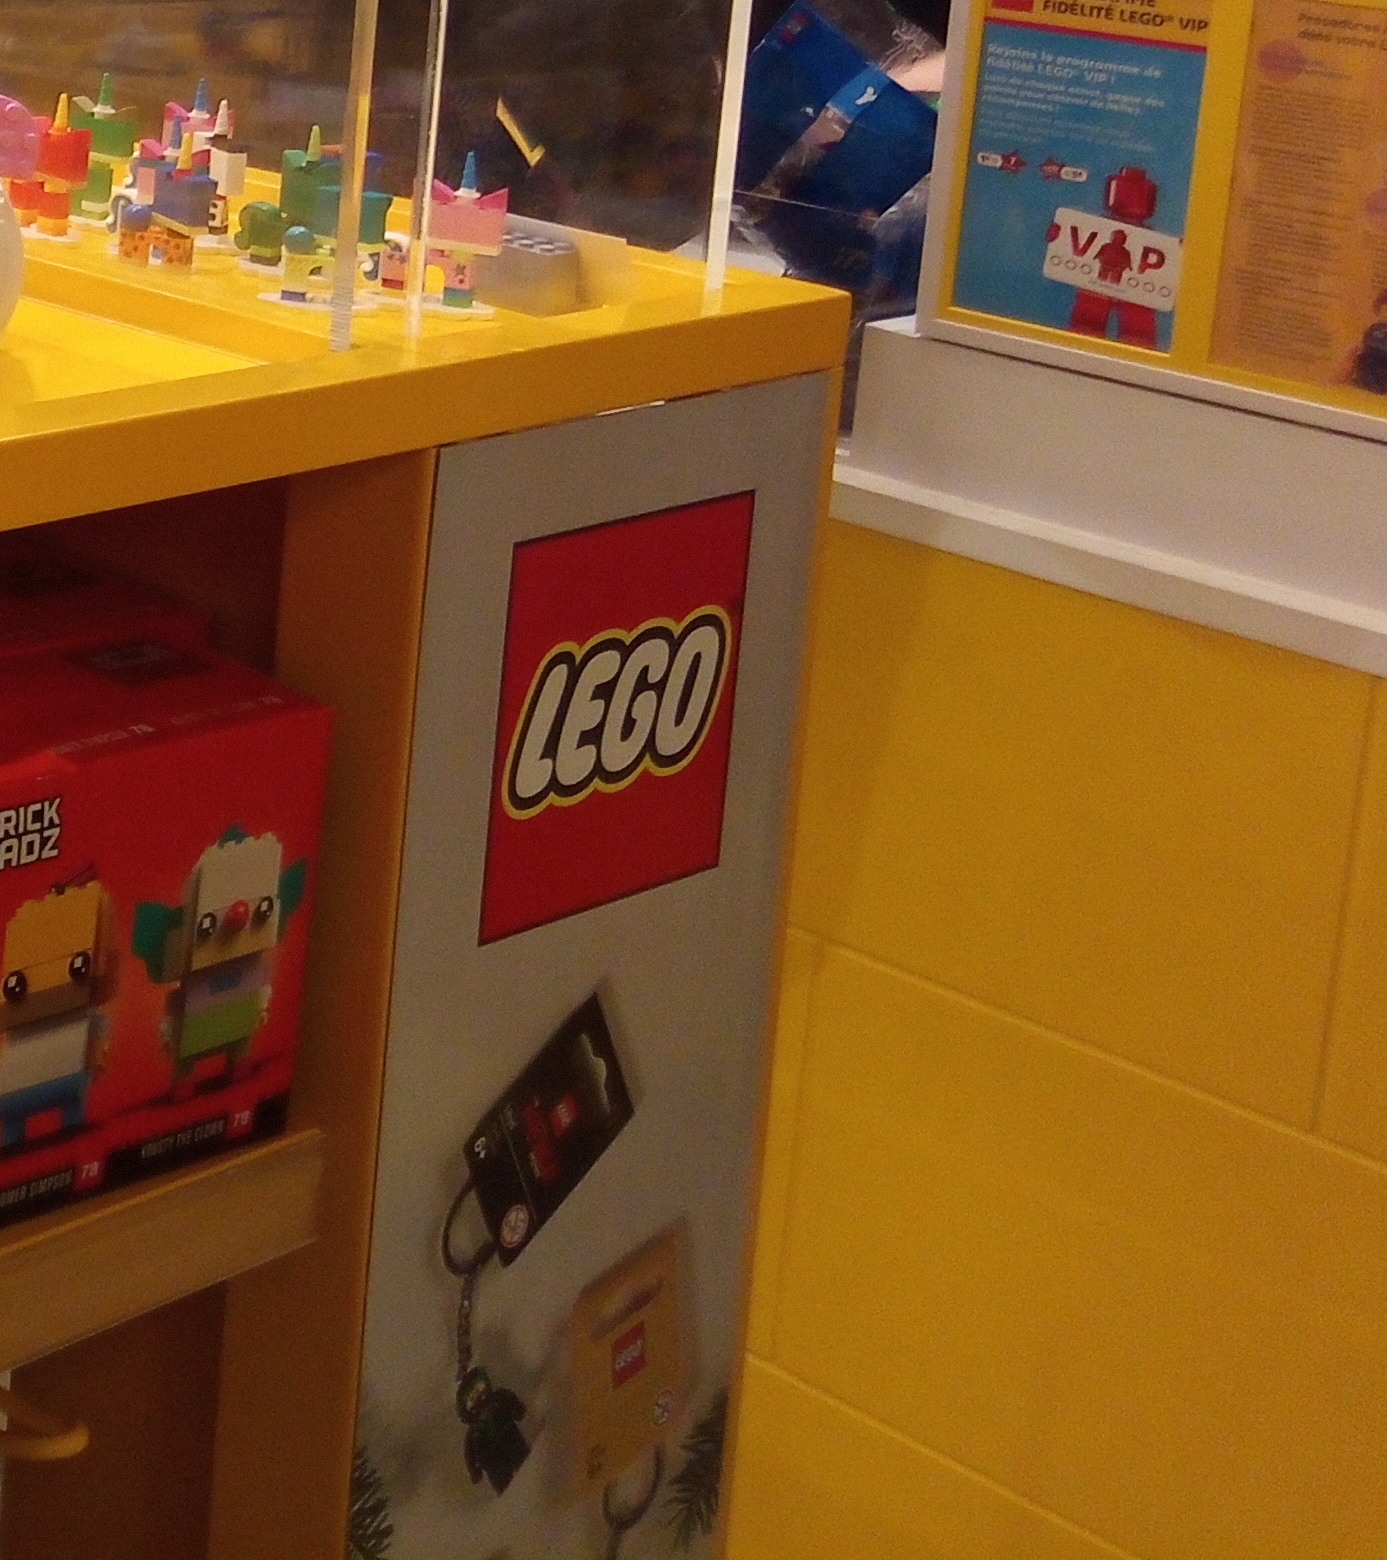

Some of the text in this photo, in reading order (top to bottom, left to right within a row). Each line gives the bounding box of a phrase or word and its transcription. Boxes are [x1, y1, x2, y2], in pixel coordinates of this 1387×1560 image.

[1042, 0, 1115, 21] FIDÉLITÉ
[1179, 17, 1209, 32] VIP
[508, 612, 728, 814] LEGO
